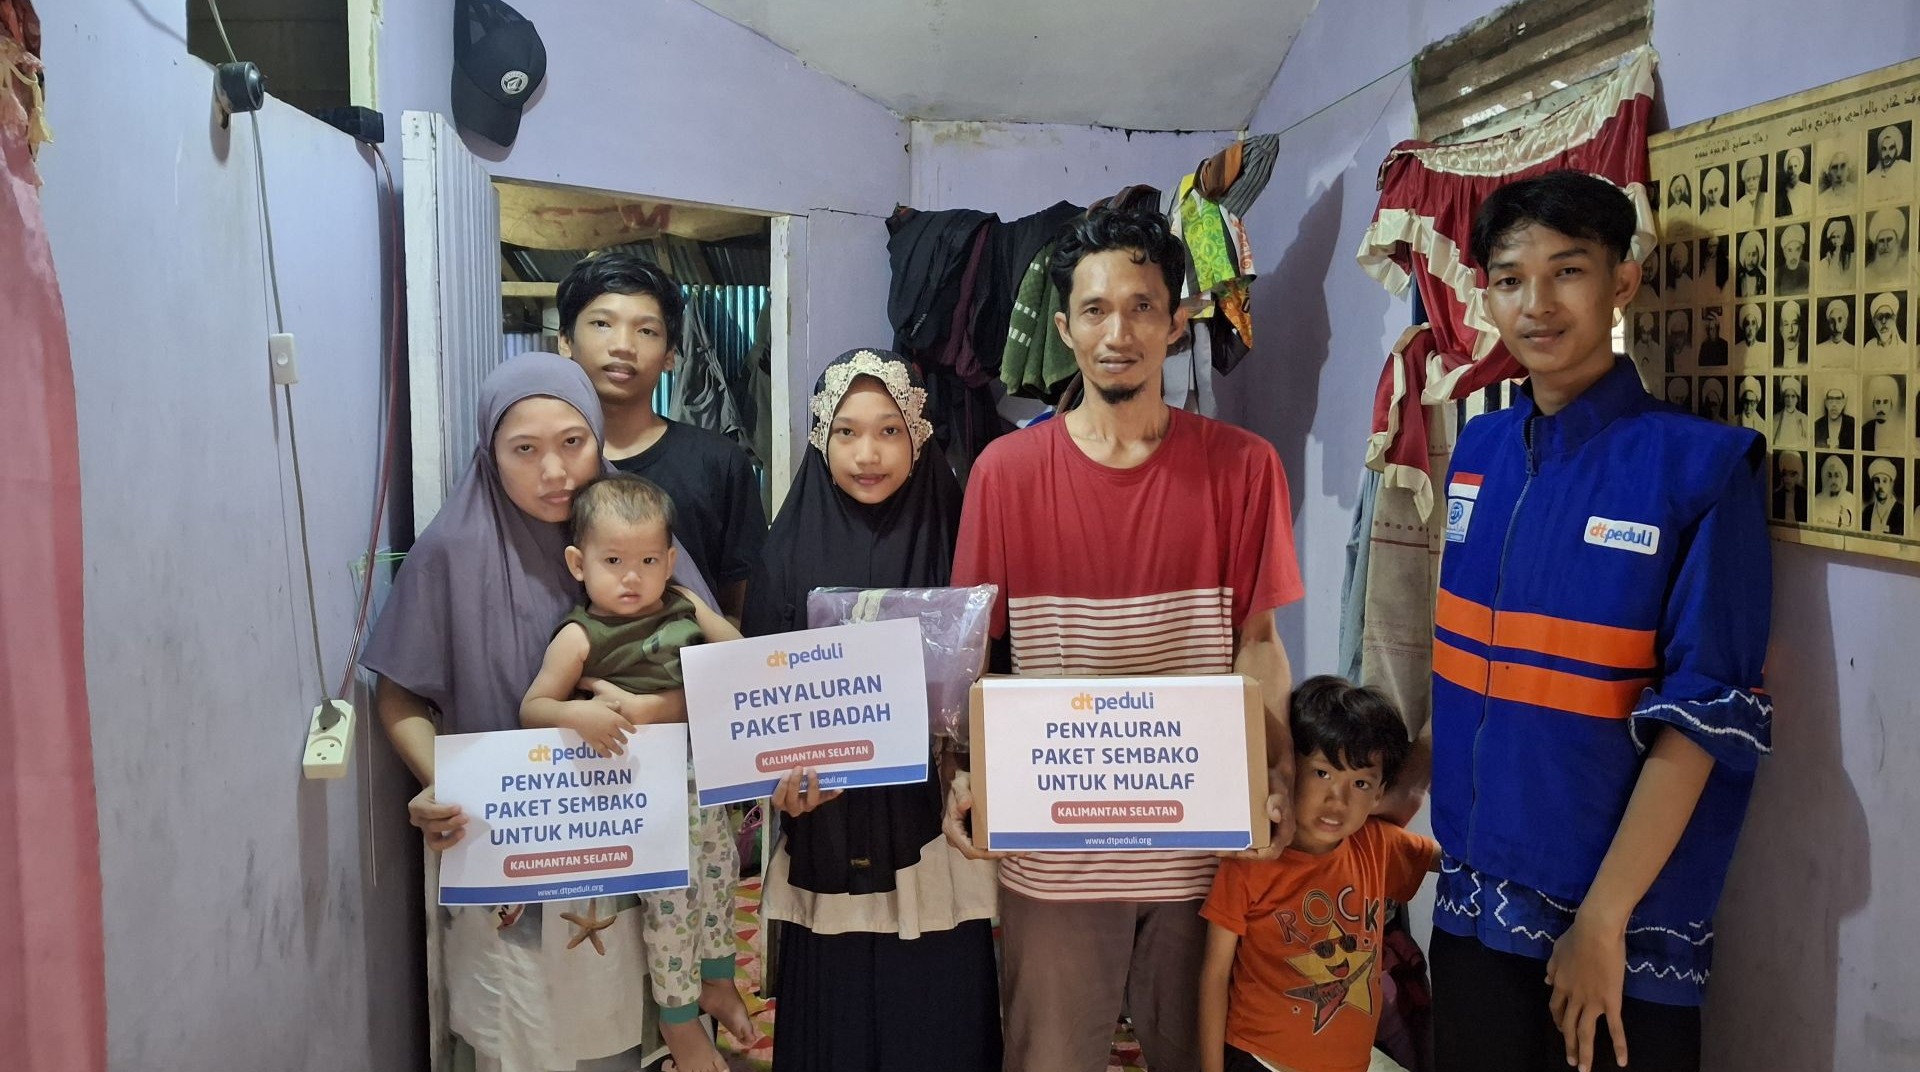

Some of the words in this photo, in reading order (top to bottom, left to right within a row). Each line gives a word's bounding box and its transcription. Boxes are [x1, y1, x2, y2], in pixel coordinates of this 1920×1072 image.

[1589, 521, 1652, 548] dtpeduli
[766, 642, 843, 669] dtpeduli
[733, 674, 883, 711] PENYALURAN
[1070, 691, 1155, 714] dtpeduli
[730, 712, 803, 741] PAKET
[809, 702, 892, 729] IBADAH
[1046, 720, 1182, 739] PENYALURAN
[527, 741, 605, 765] dtpedu
[761, 750, 826, 767] KALIMANTAN
[828, 745, 869, 758] SELATAN
[1031, 748, 1096, 765] PAKET
[1102, 746, 1199, 764] SEMBAKO
[501, 768, 632, 792] PENYALURAN
[1037, 774, 1107, 791] UNTUK
[1113, 772, 1196, 790] MUALAF
[485, 799, 551, 820] PAKET
[558, 793, 647, 814] SEMBAKO
[1057, 806, 1127, 817] KALIMANTAN
[1129, 806, 1177, 816] SELATAN
[490, 824, 562, 846] UNTUK
[568, 818, 644, 839] MUALAF
[1084, 836, 1152, 846] www.dtpeduli.org
[510, 855, 581, 871] KALIMANTAN
[583, 851, 628, 865] SELATAN
[537, 884, 604, 897] www.dtpeduli.org
[1273, 886, 1380, 944] ROCK
